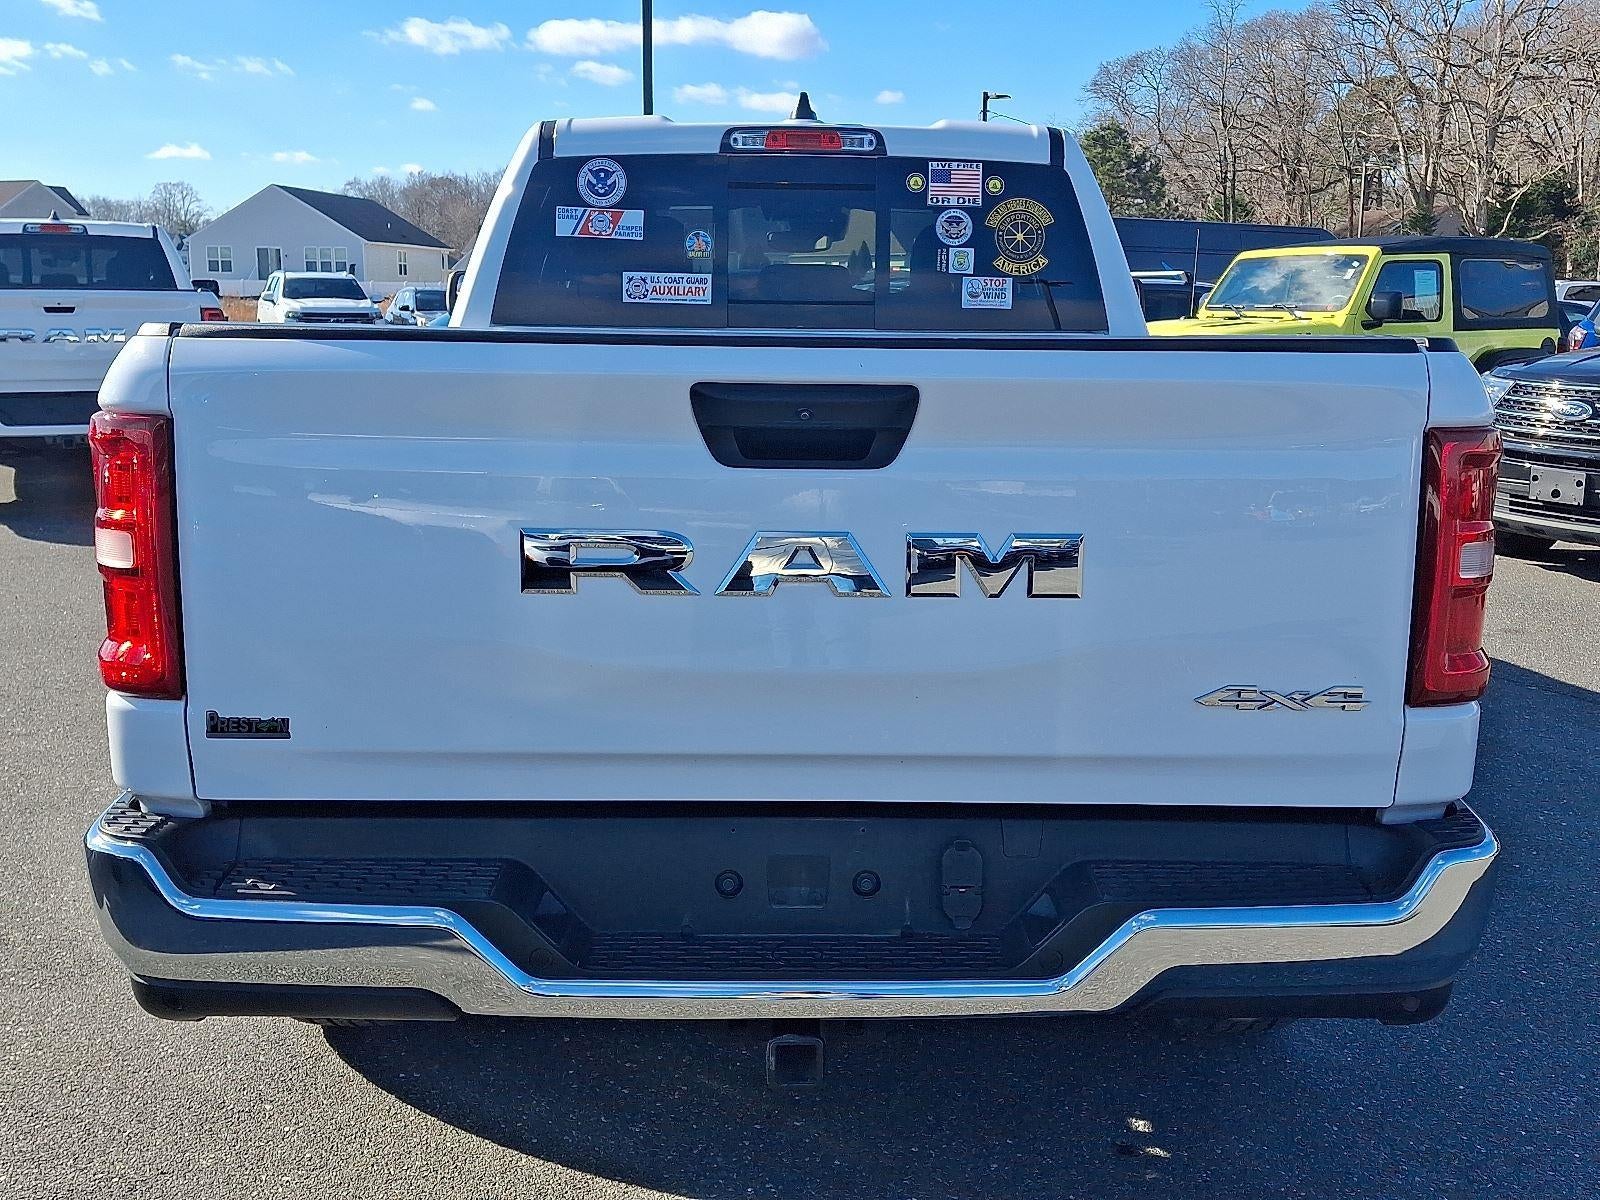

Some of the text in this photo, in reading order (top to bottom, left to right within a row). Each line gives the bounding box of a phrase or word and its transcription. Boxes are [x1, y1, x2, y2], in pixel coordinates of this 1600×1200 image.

[930, 196, 981, 205] OR DIE
[1000, 213, 1040, 230] SUPPORTING
[994, 257, 1047, 274] AMERICA
[650, 276, 708, 285] U.S. COAST GUARD
[983, 279, 1007, 287] STOP
[650, 285, 708, 297] AUXILIARY
[983, 291, 1007, 299] WIND
[0, 328, 126, 343] RAM
[519, 527, 1086, 599] RAM
[206, 711, 290, 733] PRESTN
